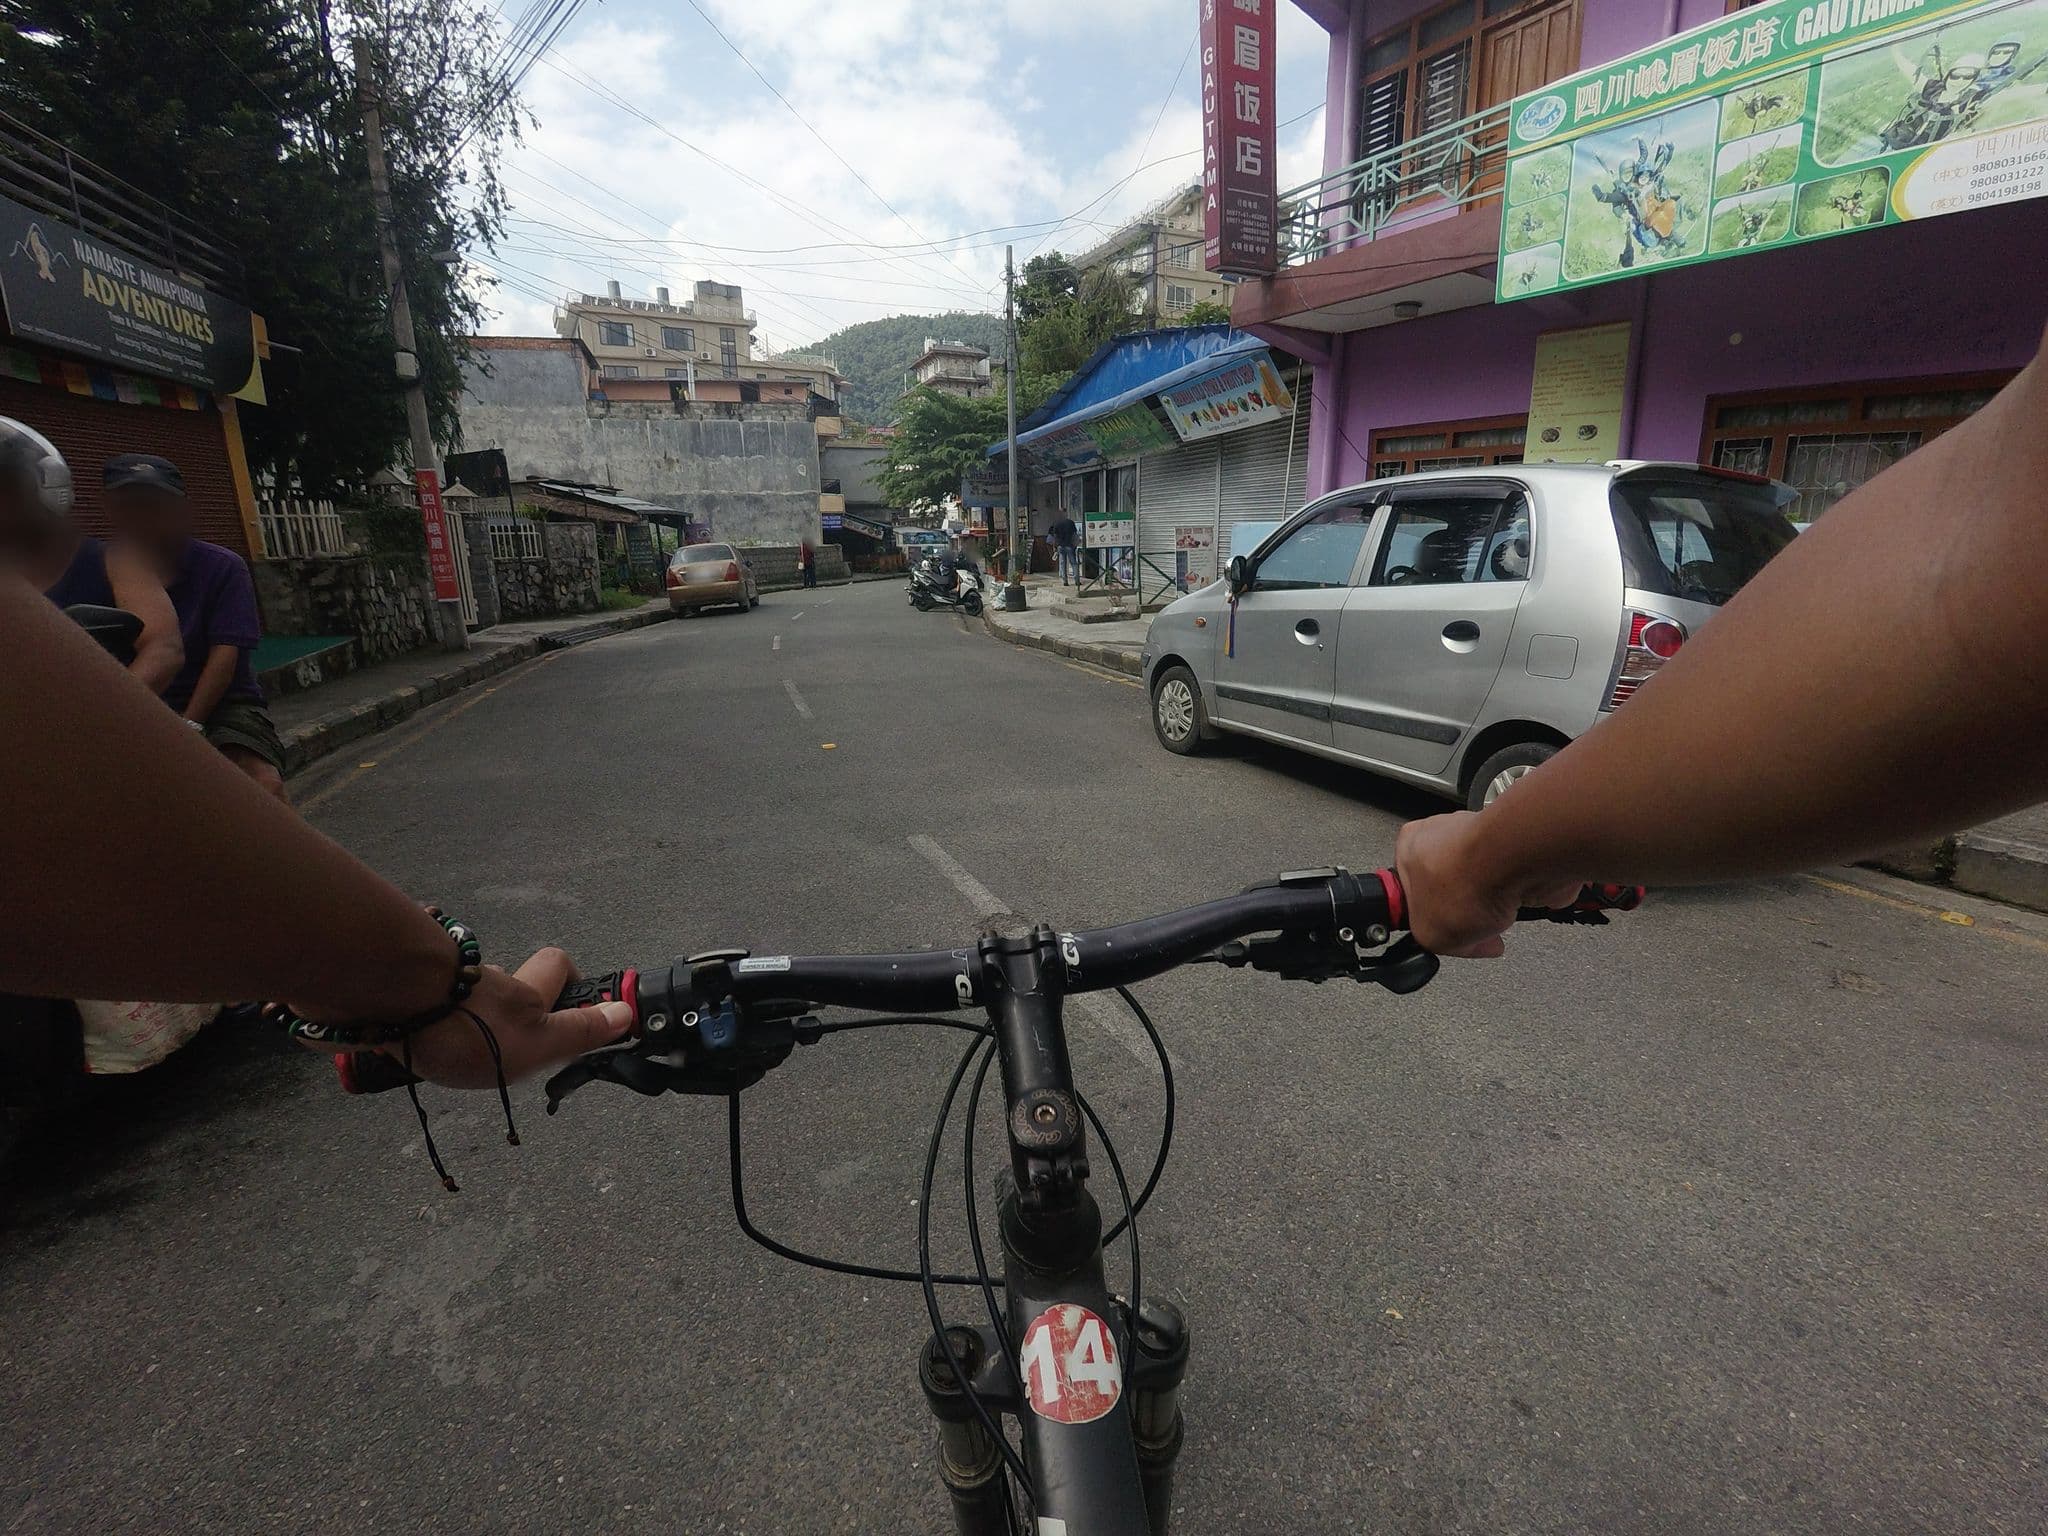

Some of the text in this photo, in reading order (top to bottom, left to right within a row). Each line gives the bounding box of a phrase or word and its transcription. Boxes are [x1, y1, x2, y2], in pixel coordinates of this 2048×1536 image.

[1575, 15, 1781, 123] 四川峨眉饭店
[1203, 46, 1216, 211] GAUTAMA
[1967, 180, 2042, 205] 9804198198
[1969, 165, 2045, 190] 9808031222
[73, 237, 208, 314] NAMASTE ANNAPURNA
[82, 267, 215, 345] ADVENTURES
[1020, 1318, 1122, 1404] 14
